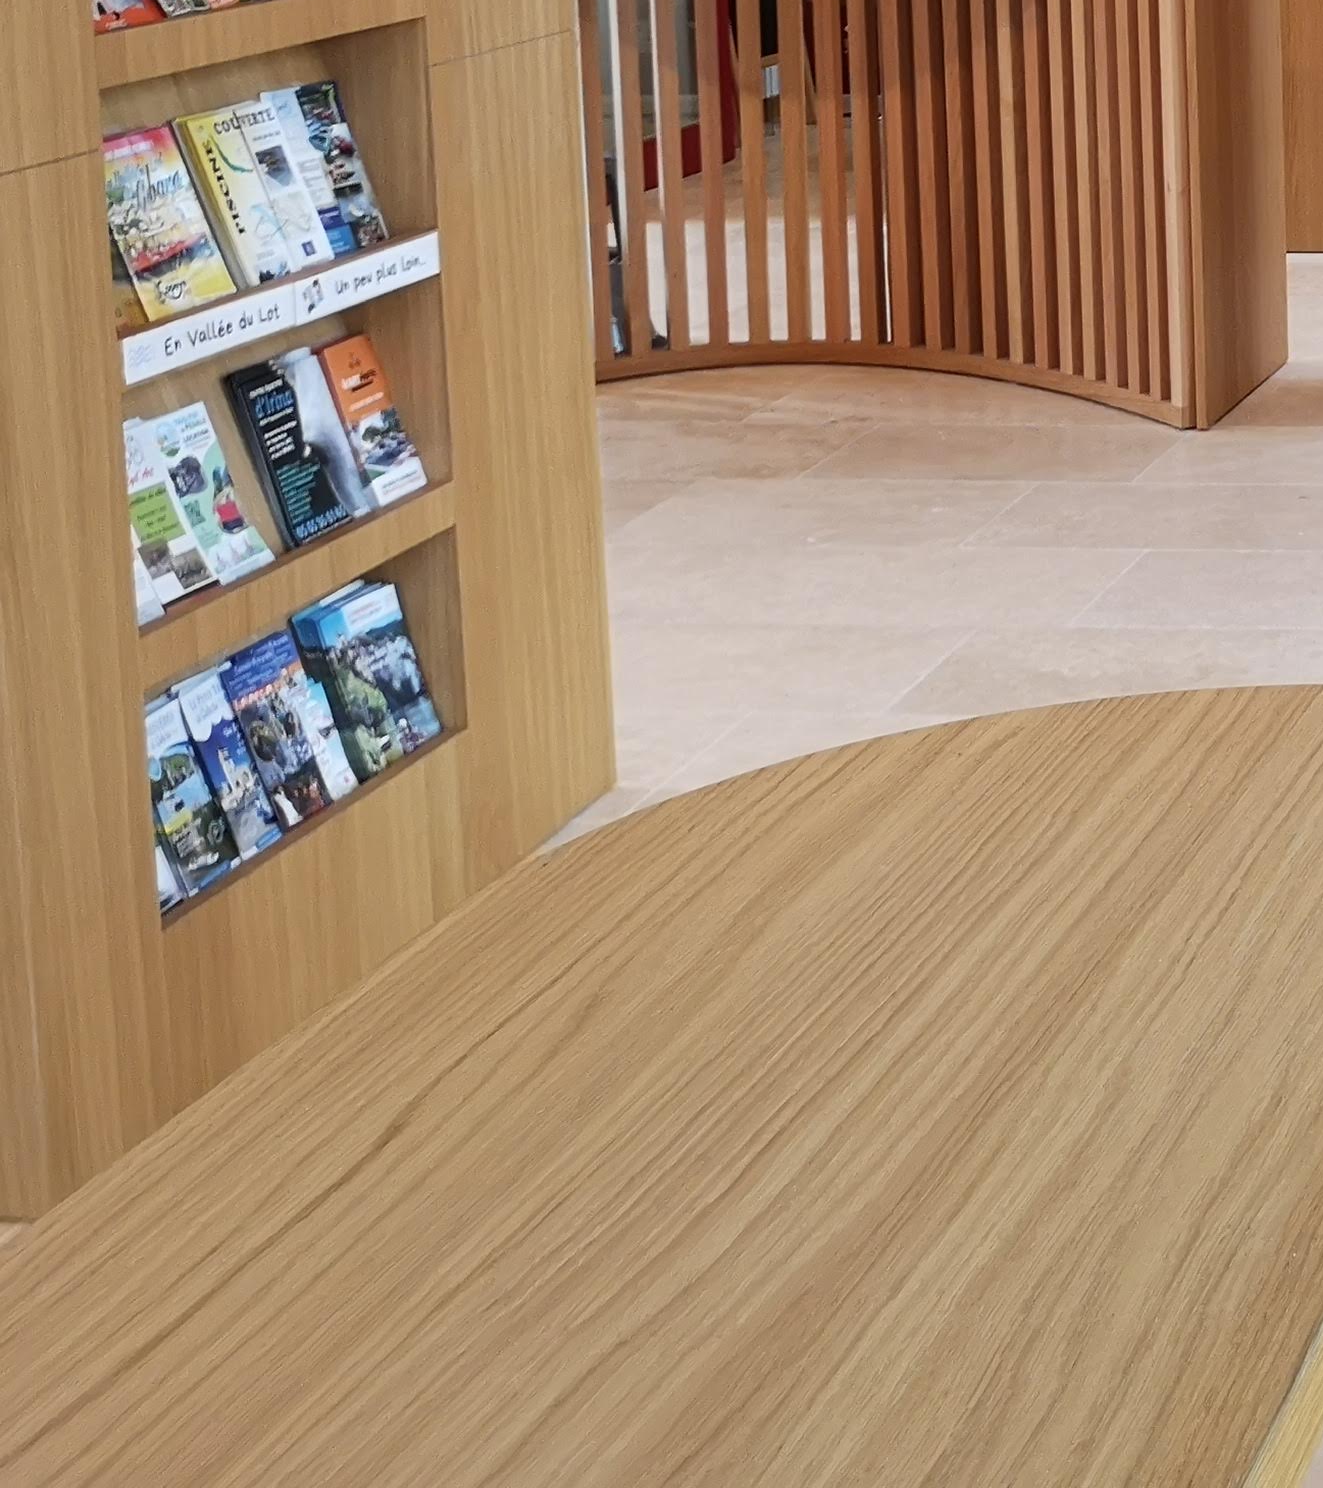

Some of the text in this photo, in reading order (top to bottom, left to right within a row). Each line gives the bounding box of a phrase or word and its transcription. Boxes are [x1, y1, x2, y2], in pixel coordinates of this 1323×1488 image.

[352, 273, 373, 296] peu
[374, 262, 398, 289] plus
[163, 303, 282, 357] En Vallée du Lot
